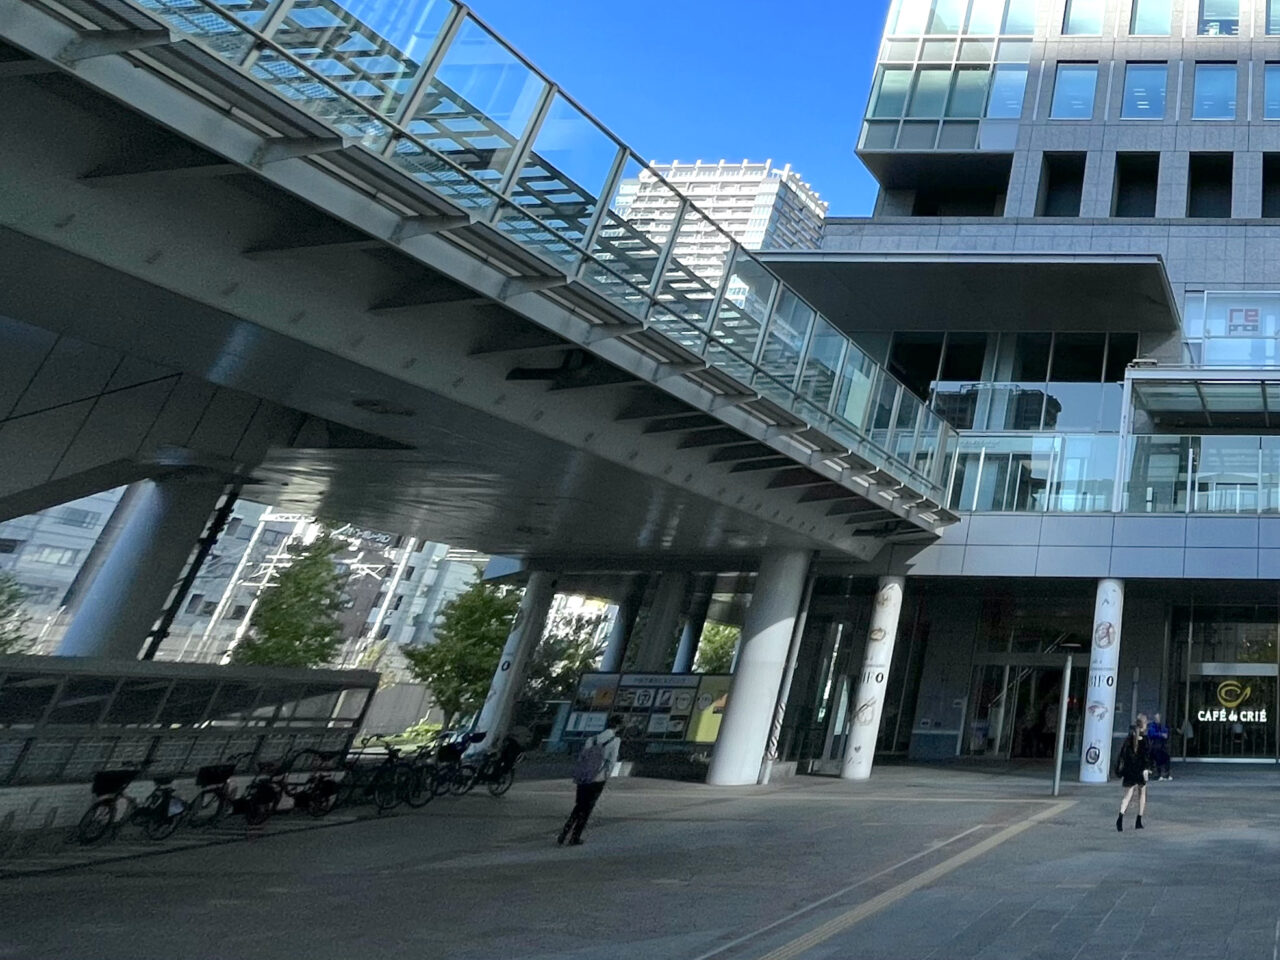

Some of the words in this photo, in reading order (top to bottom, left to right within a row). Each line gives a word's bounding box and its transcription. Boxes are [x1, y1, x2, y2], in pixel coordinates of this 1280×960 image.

[1229, 308, 1259, 323] re
[1197, 708, 1227, 722] CAFÉ
[1228, 709, 1239, 722] de
[1240, 708, 1267, 722] CRIÉ
